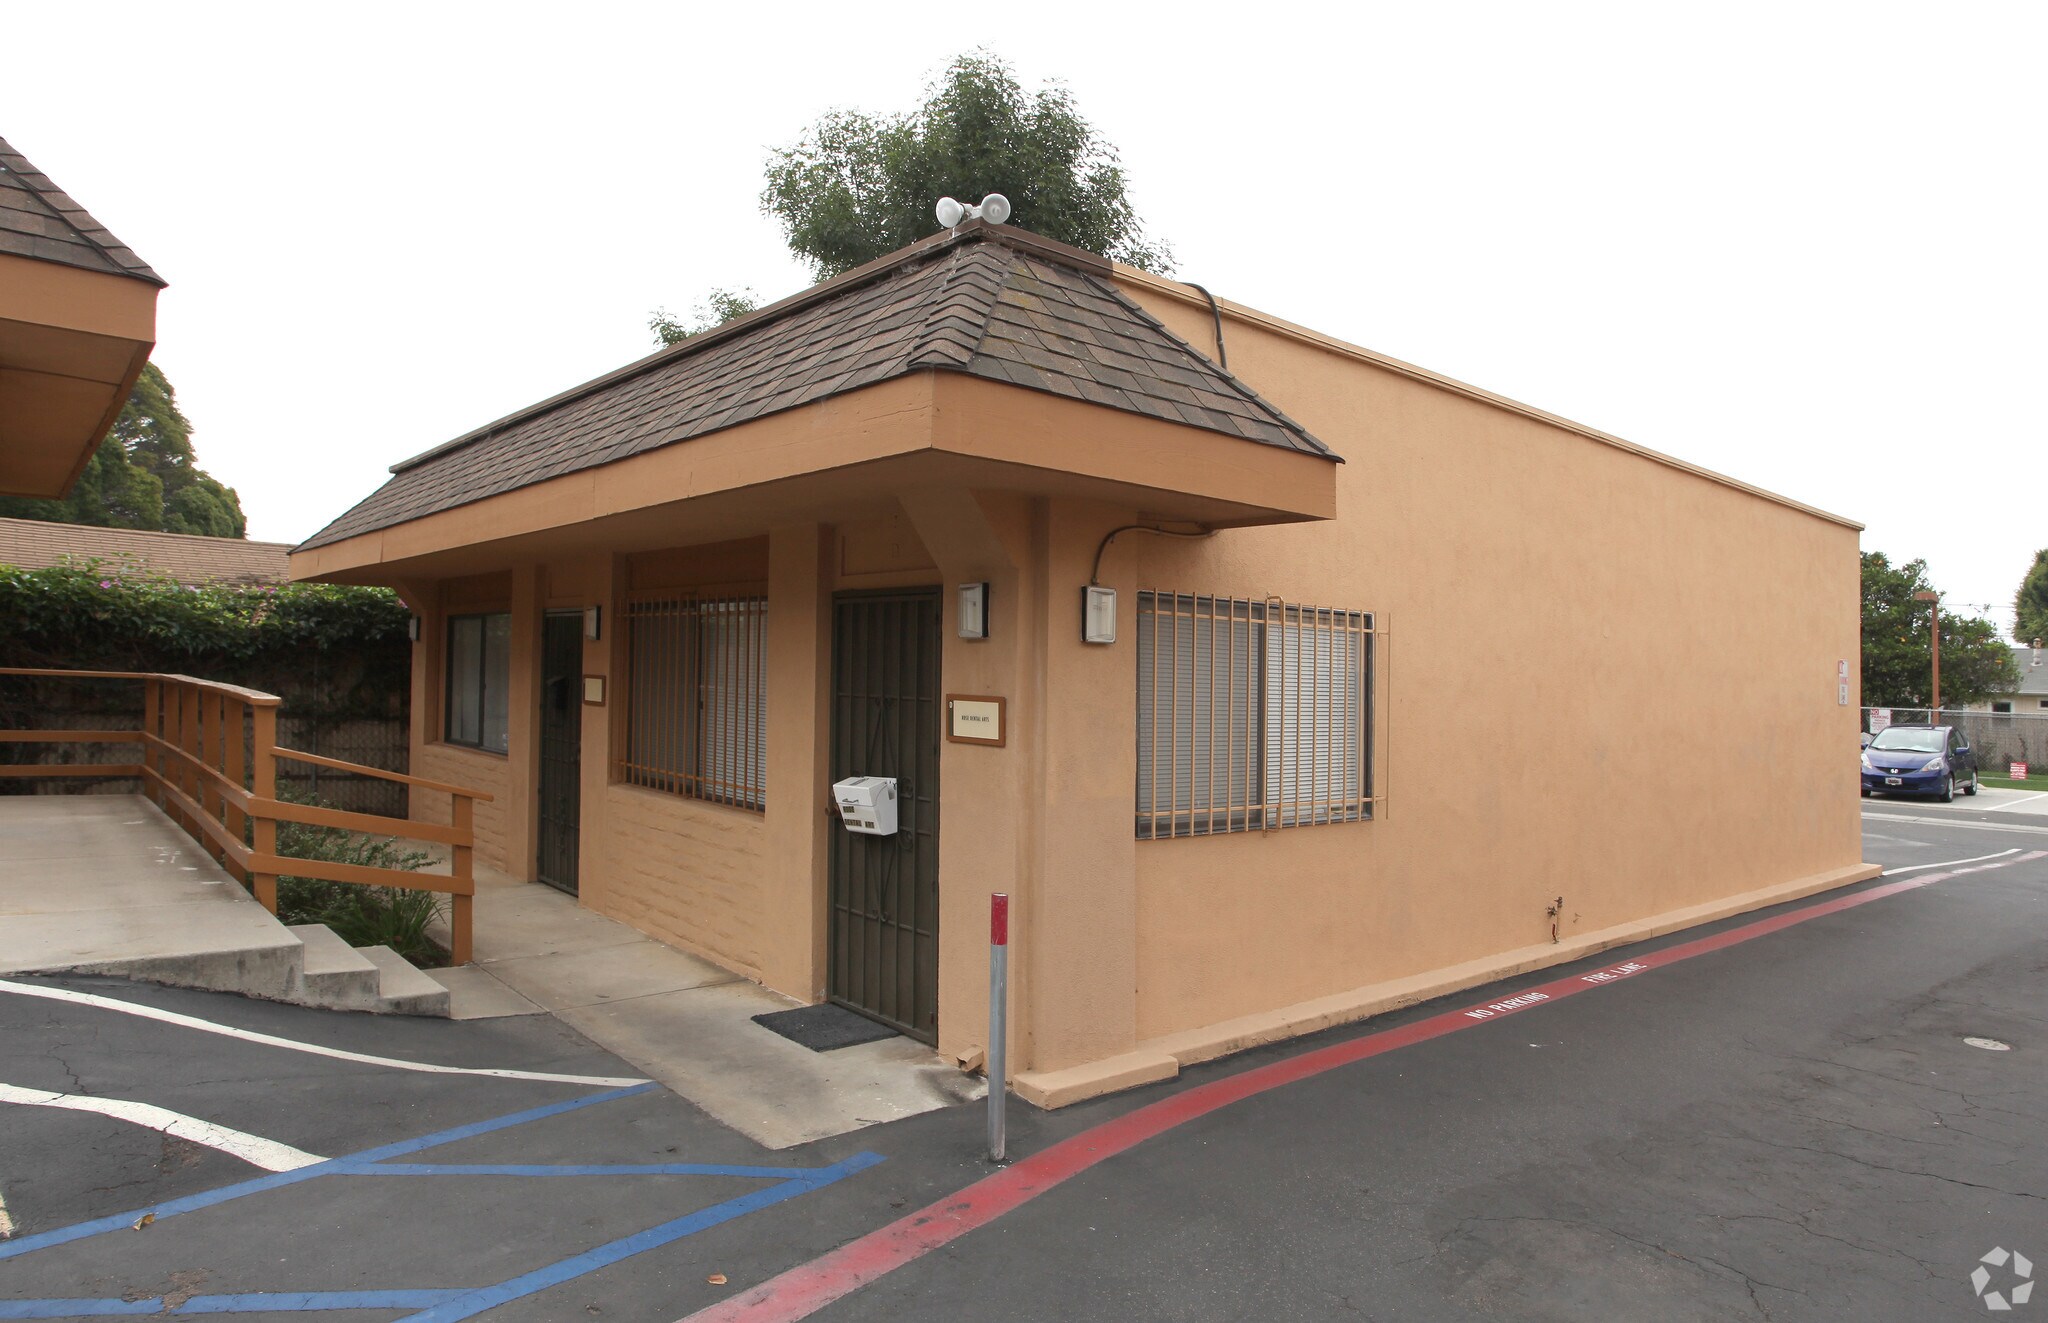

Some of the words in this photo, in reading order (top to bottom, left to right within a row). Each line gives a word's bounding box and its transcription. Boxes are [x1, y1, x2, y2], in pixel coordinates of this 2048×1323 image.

[1581, 972, 1618, 984] FIRE
[1609, 962, 1648, 975] LANE
[1464, 1009, 1494, 1020] NO
[1488, 992, 1550, 1012] PARKING
